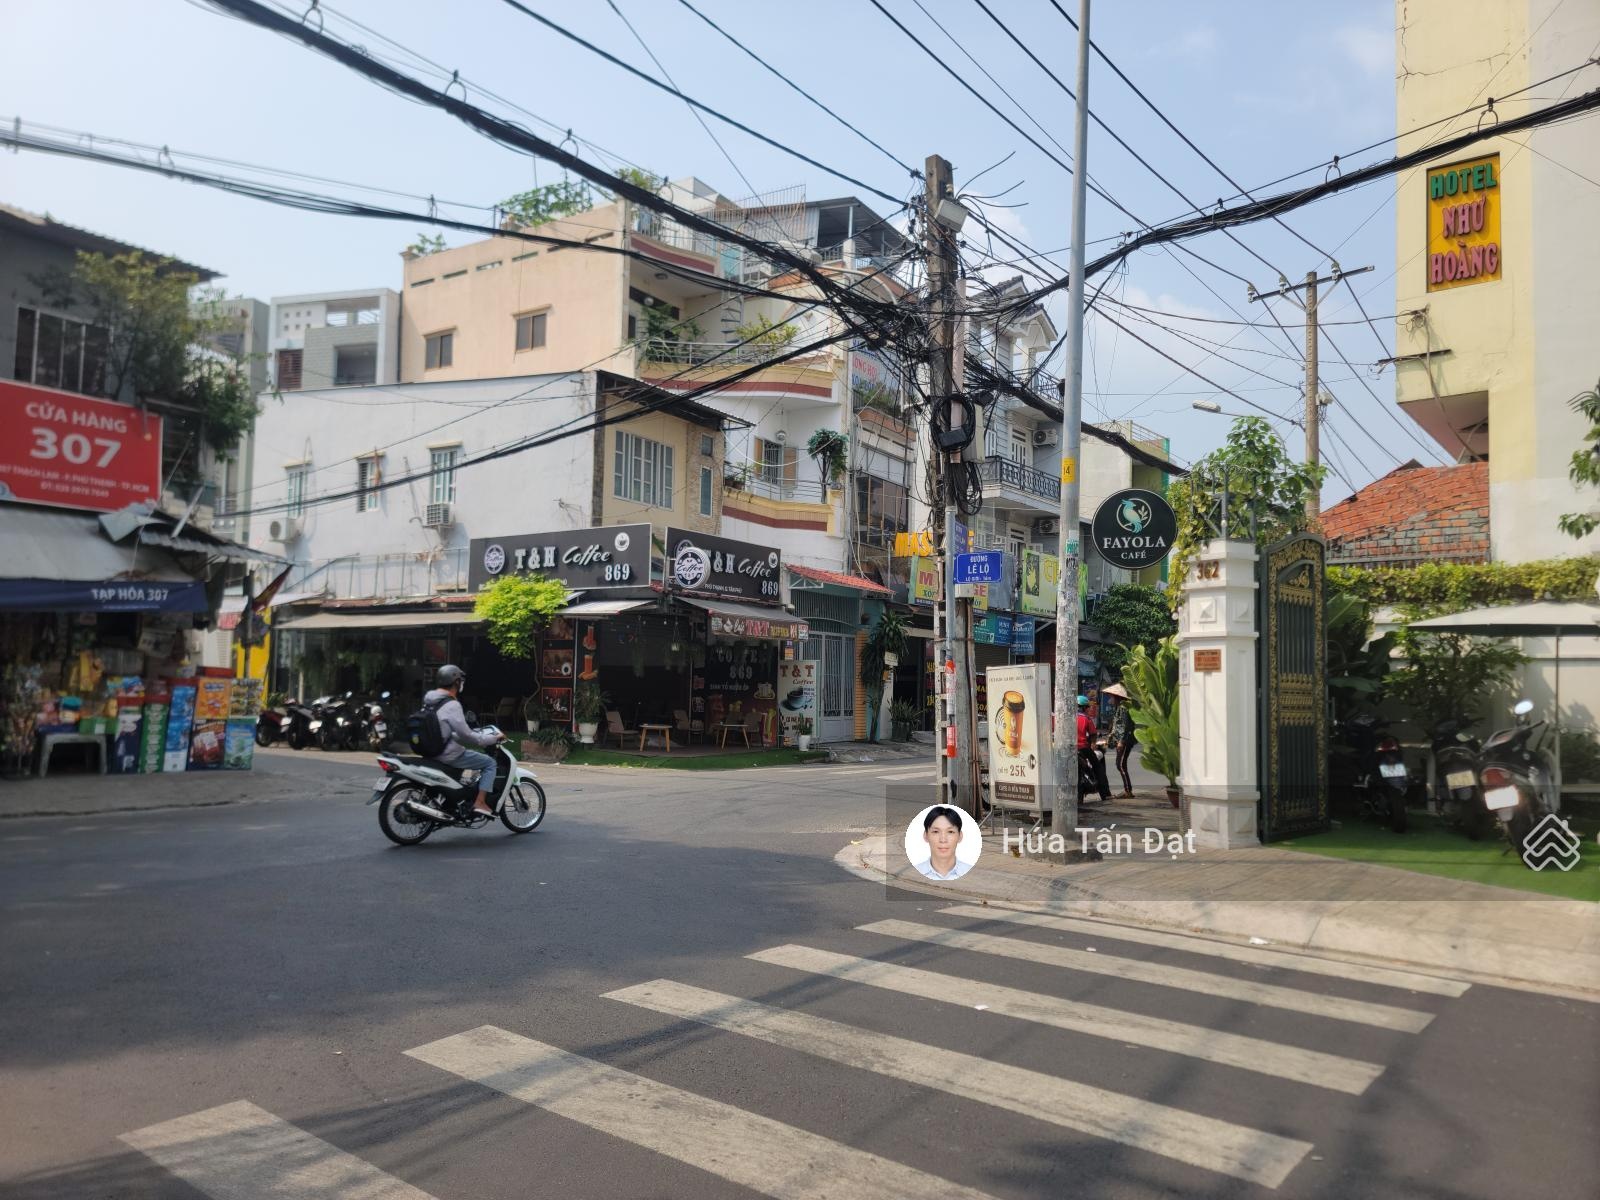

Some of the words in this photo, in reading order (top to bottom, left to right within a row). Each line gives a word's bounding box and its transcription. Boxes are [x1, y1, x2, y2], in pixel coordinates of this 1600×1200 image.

[1431, 163, 1497, 199] HOTEL
[1442, 193, 1487, 238] NHƯ
[1431, 241, 1498, 284] HOÀNG
[25, 401, 67, 423] CỬA
[72, 411, 127, 433] HÀNG
[30, 427, 121, 468] 307
[1103, 536, 1166, 549] FAYOLA
[562, 544, 611, 566] Coffee
[1121, 549, 1147, 559] CAFÉ
[604, 563, 630, 581] 869
[677, 562, 703, 573] Coffee
[738, 558, 771, 578] Coffee
[967, 563, 977, 575] LÊ
[91, 588, 116, 603] TẠP
[147, 588, 169, 601] 307
[762, 580, 778, 596] 869
[729, 665, 753, 680] 869
[1010, 764, 1026, 777] 25K
